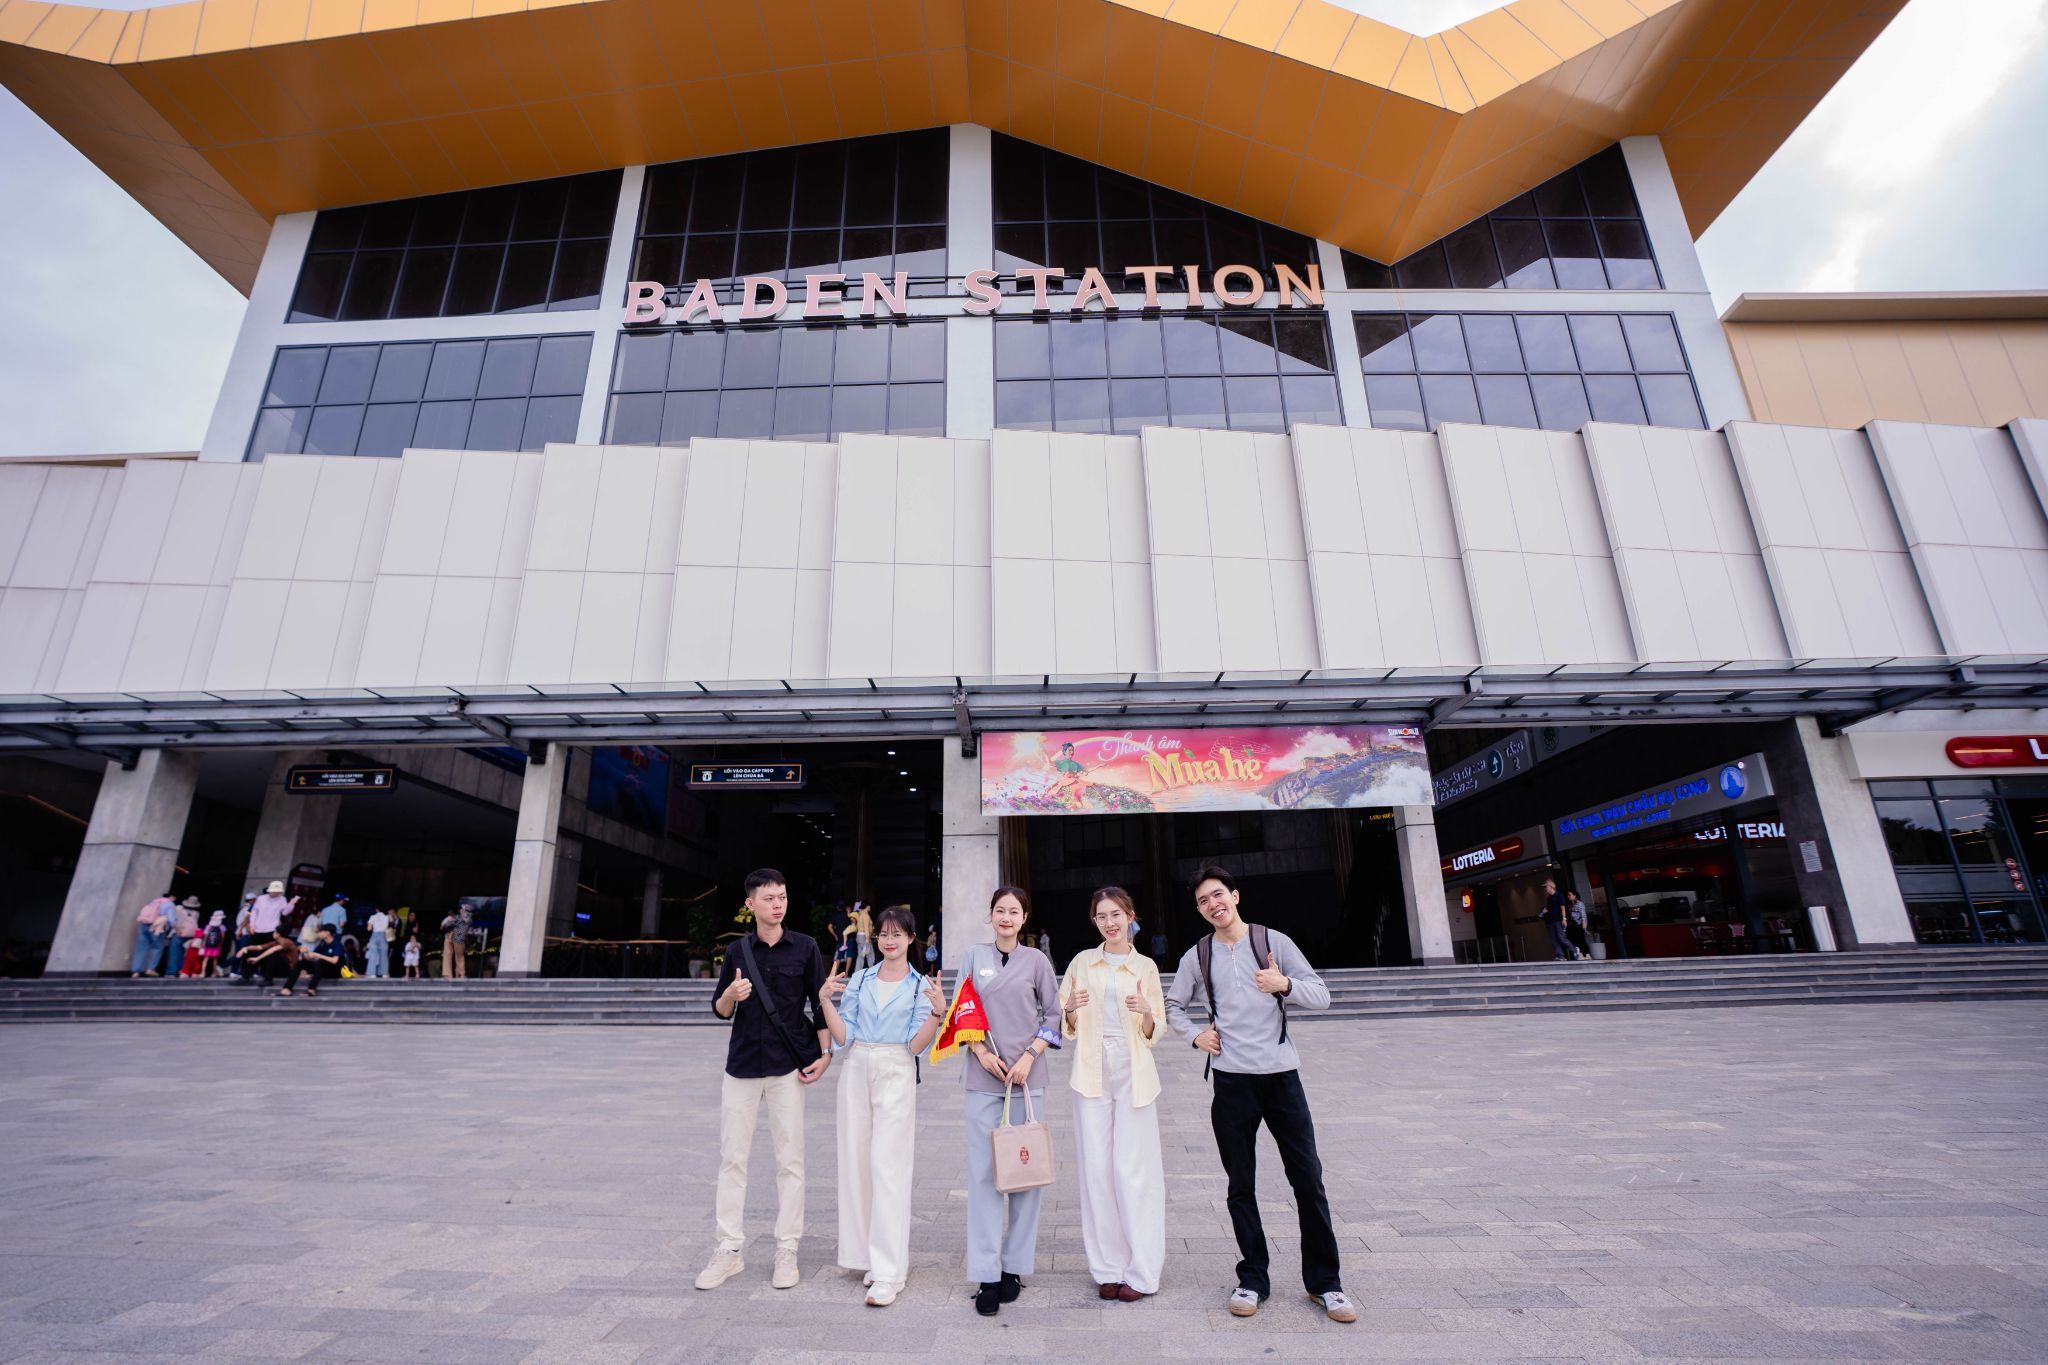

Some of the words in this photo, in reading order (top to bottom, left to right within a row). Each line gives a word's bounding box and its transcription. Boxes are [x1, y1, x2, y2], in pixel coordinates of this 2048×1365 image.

[622, 272, 908, 327] BADEN
[960, 263, 1326, 315] STATION
[1098, 732, 1154, 762] Thanh
[1157, 735, 1181, 750] âm
[1627, 793, 1656, 814] CHÂU
[1657, 789, 1674, 806] HẠ
[1675, 778, 1709, 801] LONG
[1453, 847, 1495, 871] LOTTERIA
